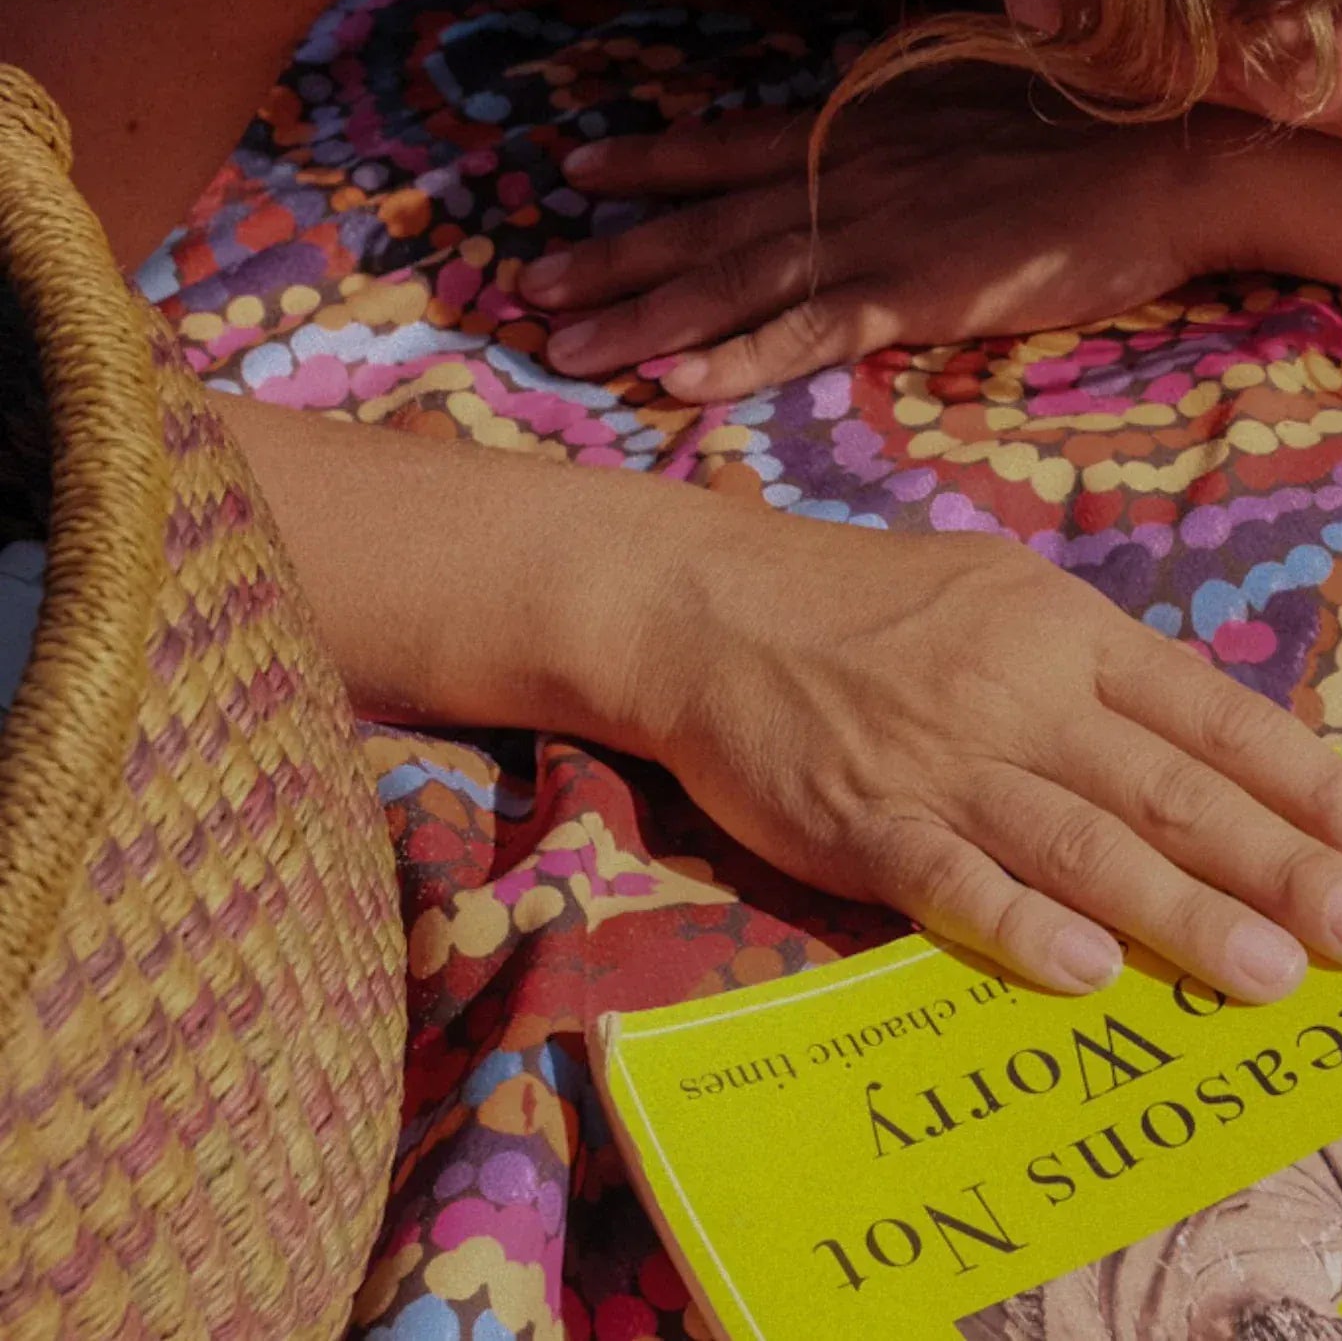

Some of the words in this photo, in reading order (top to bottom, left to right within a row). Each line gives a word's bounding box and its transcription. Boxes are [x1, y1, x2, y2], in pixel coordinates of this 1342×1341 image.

[965, 975, 1018, 1006] in
[1172, 972, 1228, 1018] o
[806, 998, 957, 1069] chaotic
[679, 1053, 798, 1100] times
[867, 1012, 1185, 1159] Worry
[813, 1181, 1030, 1292] Not
